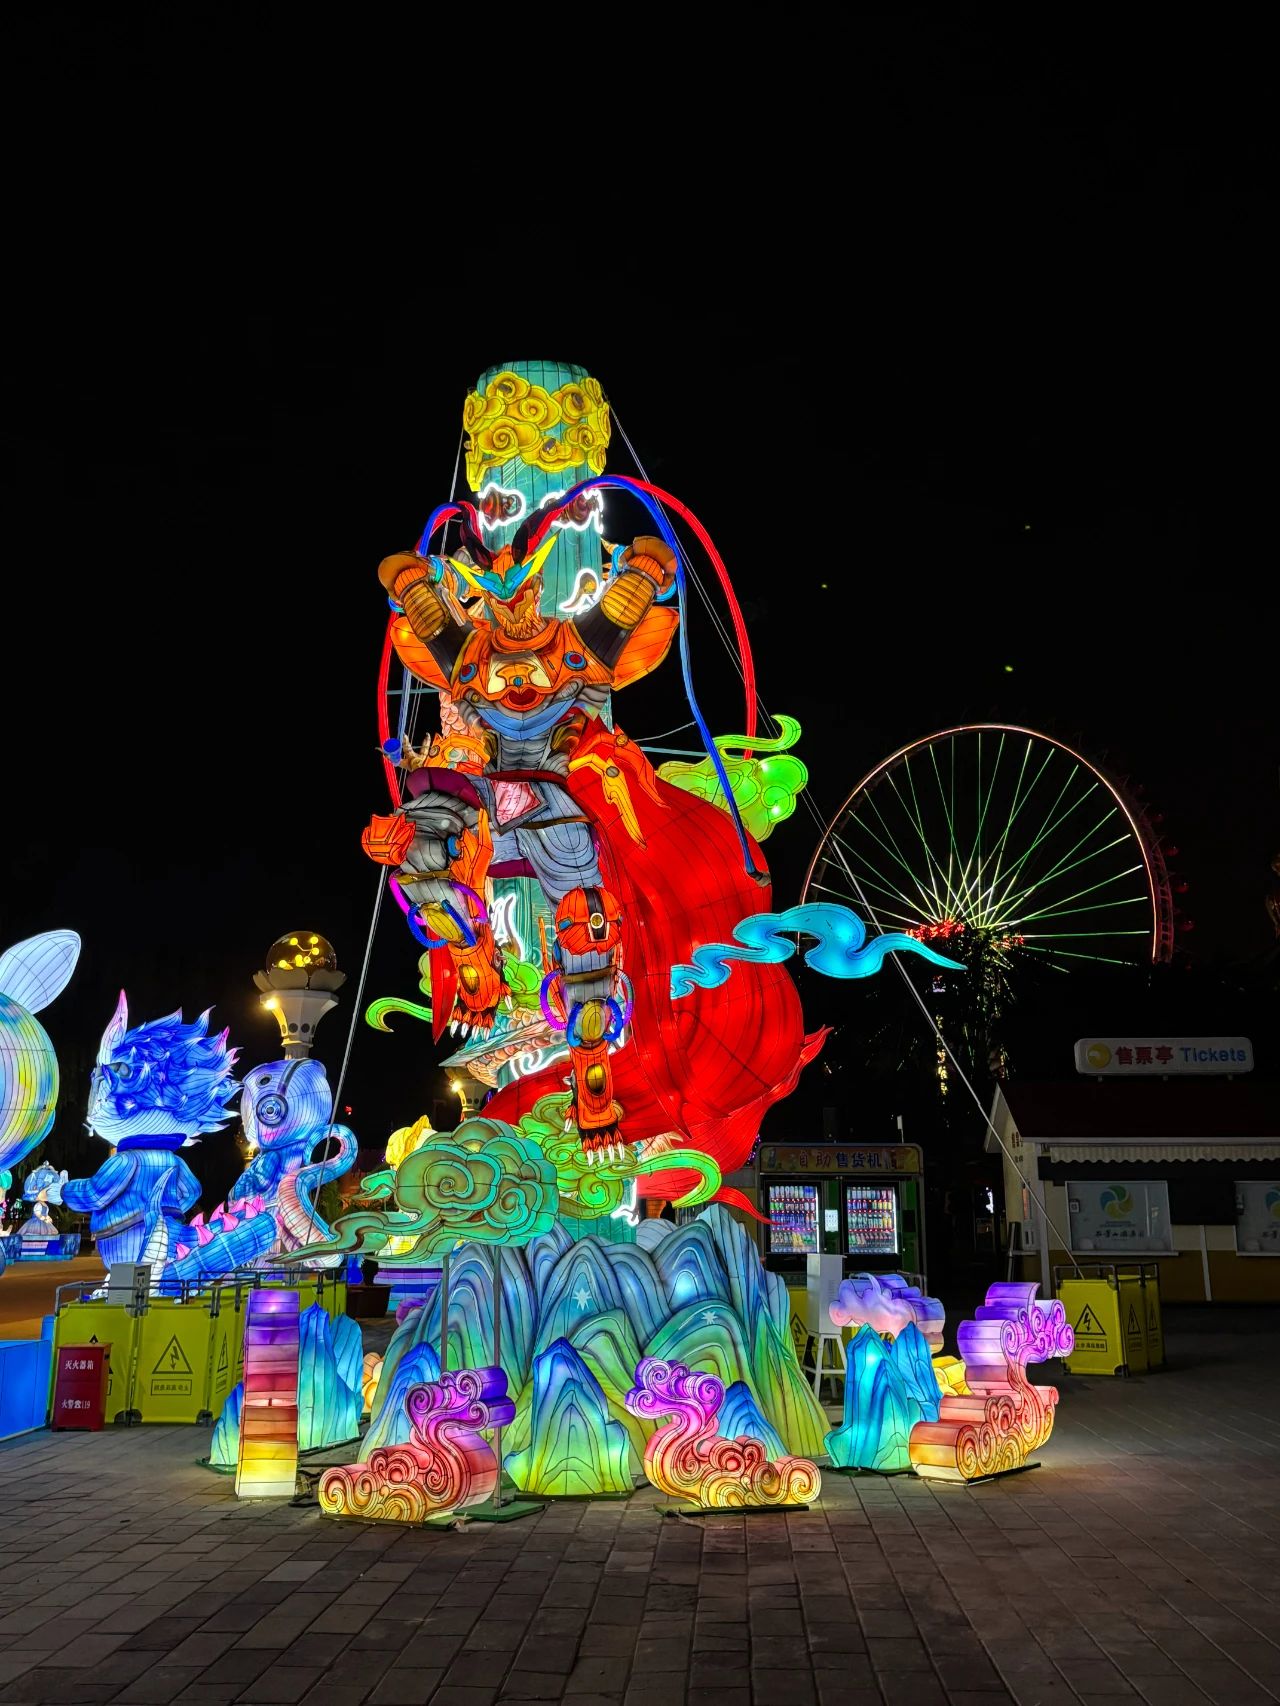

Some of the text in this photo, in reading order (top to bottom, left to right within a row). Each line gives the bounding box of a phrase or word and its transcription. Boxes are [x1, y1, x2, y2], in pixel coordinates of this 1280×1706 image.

[1115, 1045, 1247, 1065] 售票亭 Tickets
[799, 1149, 882, 1169] 自助售货机
[64, 1359, 94, 1370] 灭火器箱
